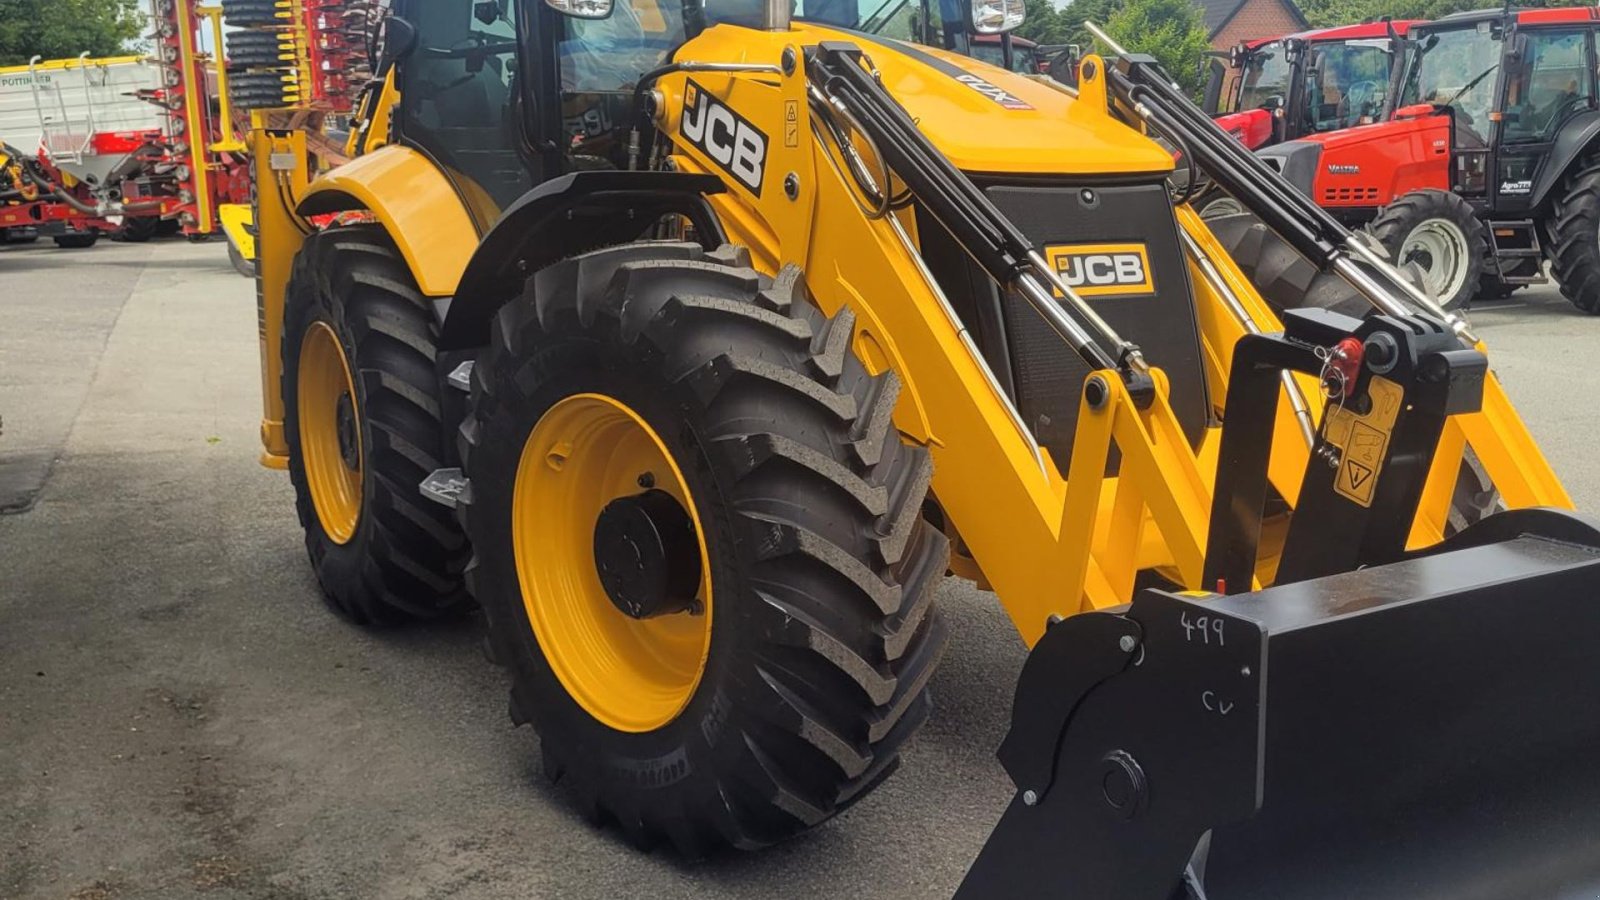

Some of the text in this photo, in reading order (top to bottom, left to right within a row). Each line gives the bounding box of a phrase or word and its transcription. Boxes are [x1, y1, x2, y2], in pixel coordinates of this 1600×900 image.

[682, 92, 765, 188] JCB
[1061, 255, 1144, 285] JCB
[1181, 611, 1224, 646] 499
